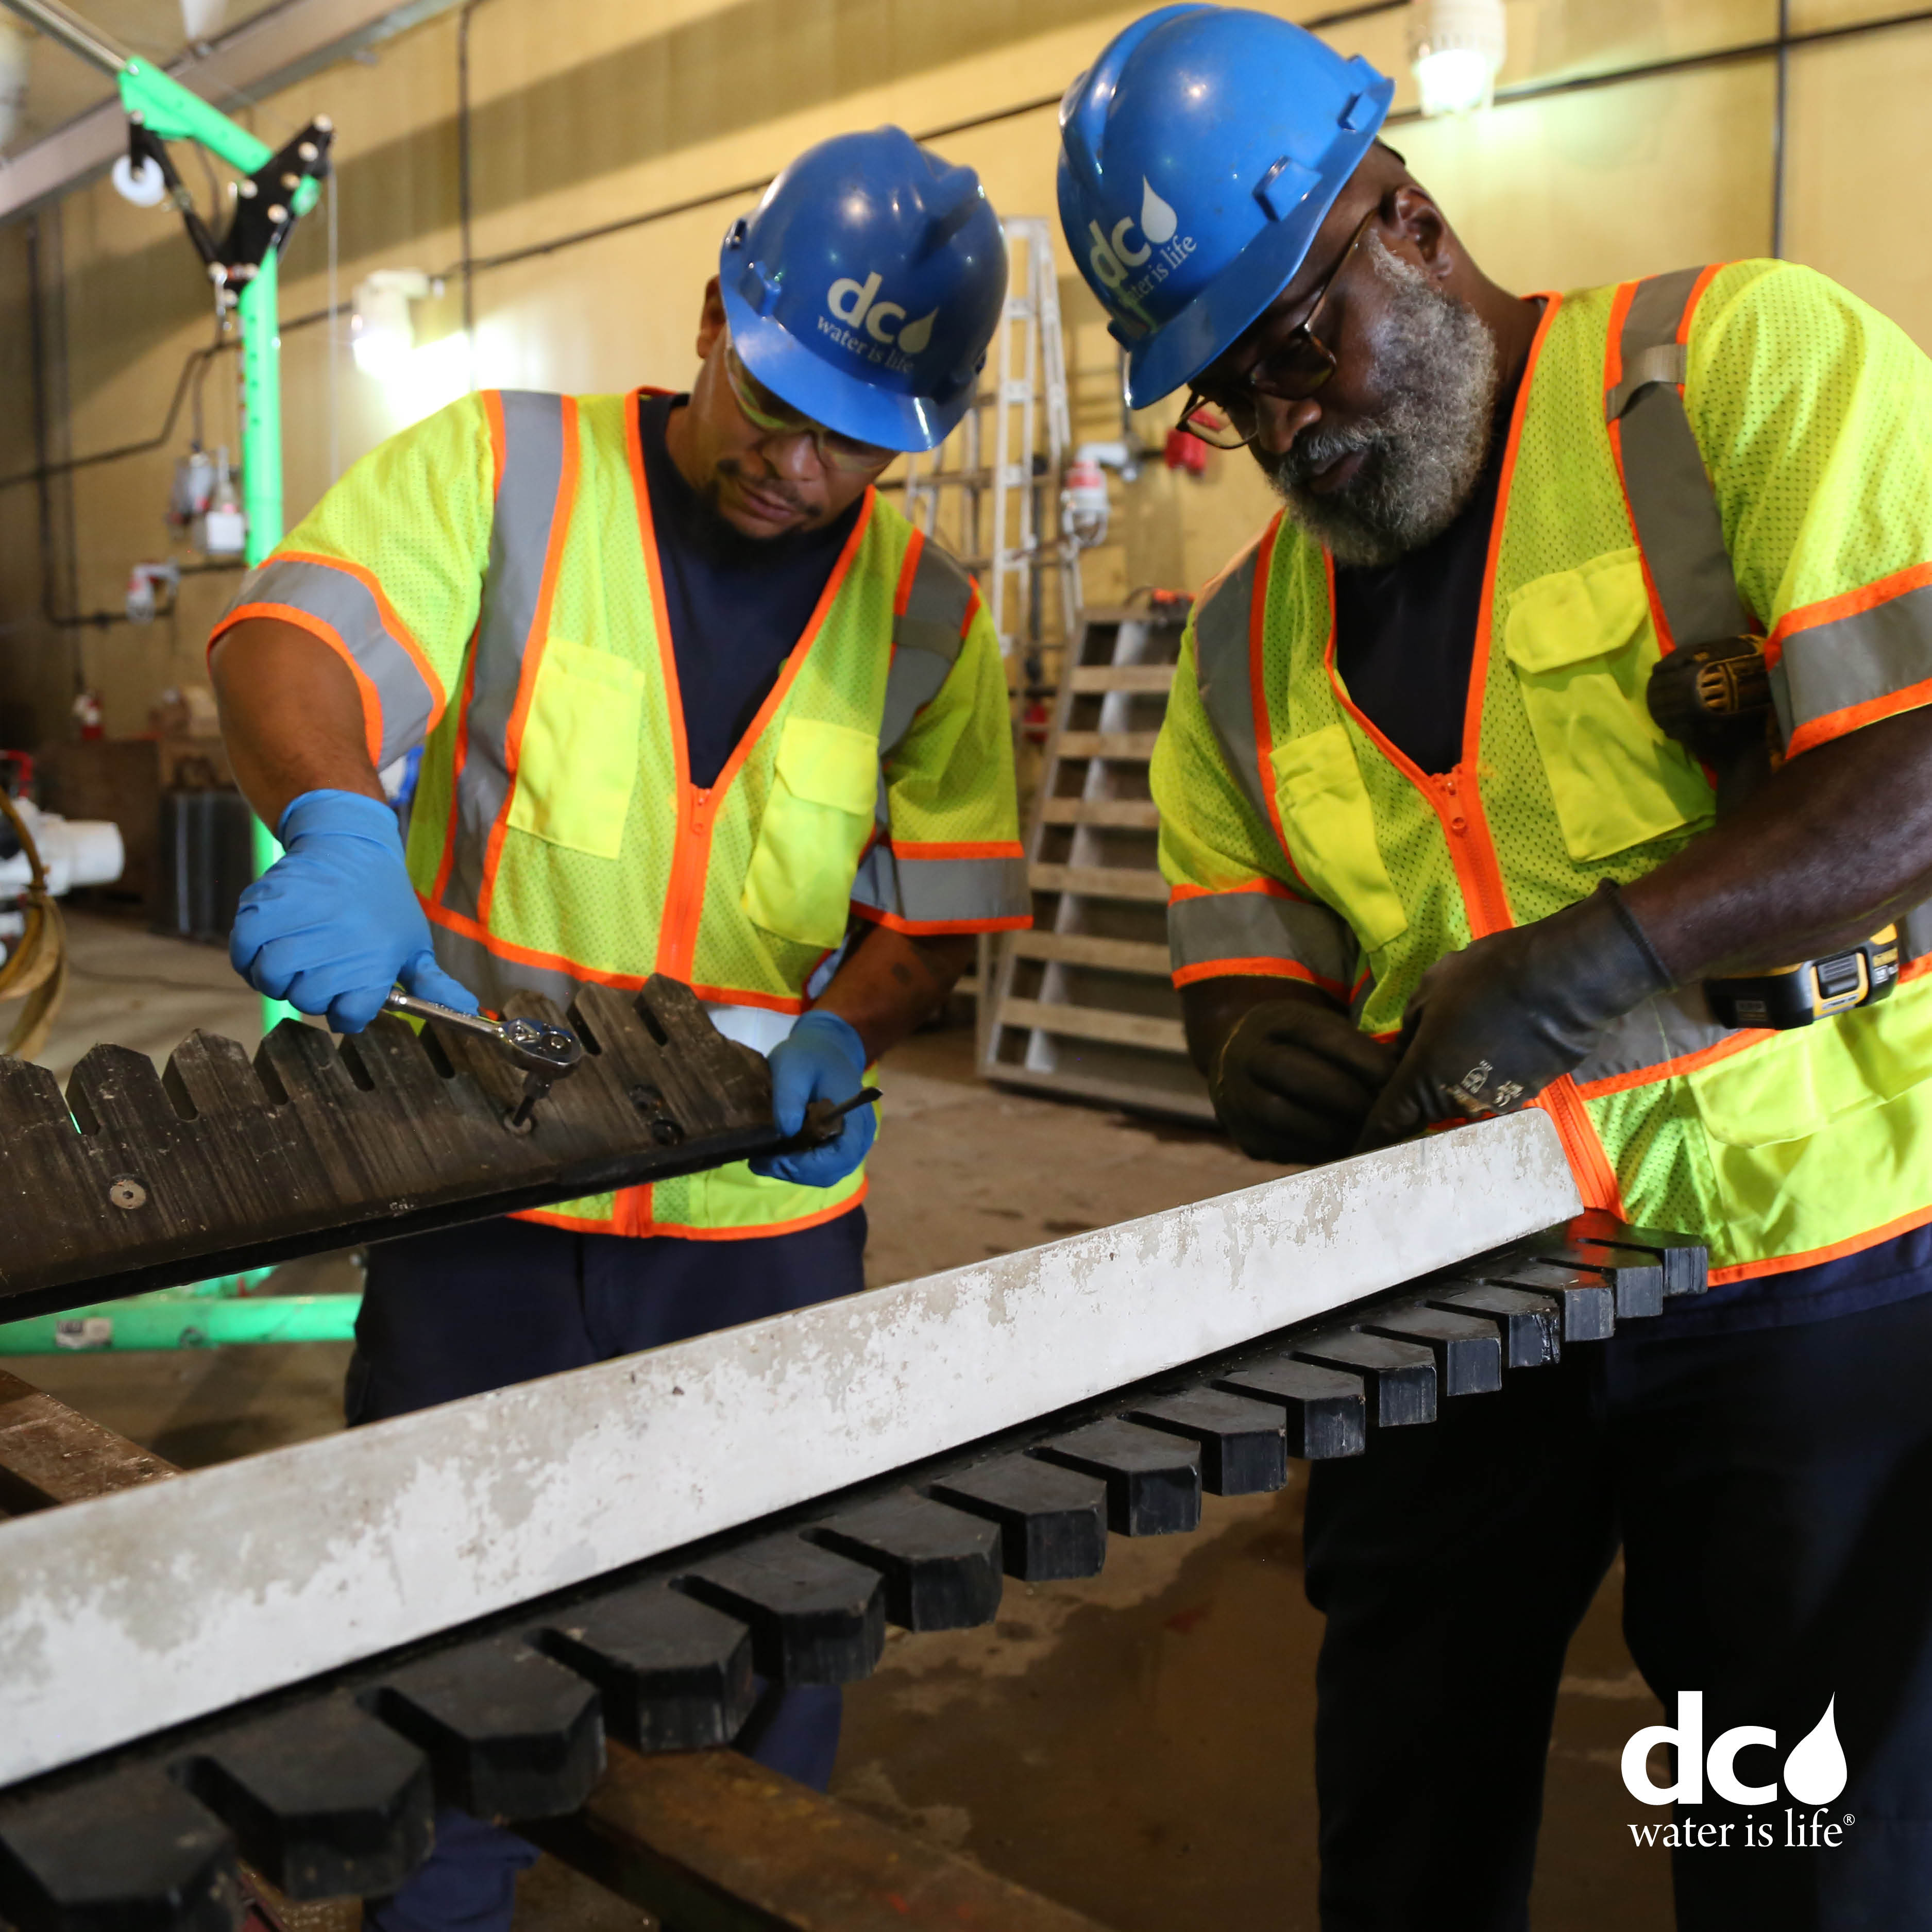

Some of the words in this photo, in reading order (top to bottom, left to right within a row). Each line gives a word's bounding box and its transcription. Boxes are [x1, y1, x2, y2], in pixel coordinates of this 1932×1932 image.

[1088, 216, 1151, 289] dc
[1148, 264, 1168, 282] is
[1159, 235, 1197, 269] life
[827, 272, 906, 344] dc
[817, 315, 867, 354] water
[868, 344, 884, 363] is
